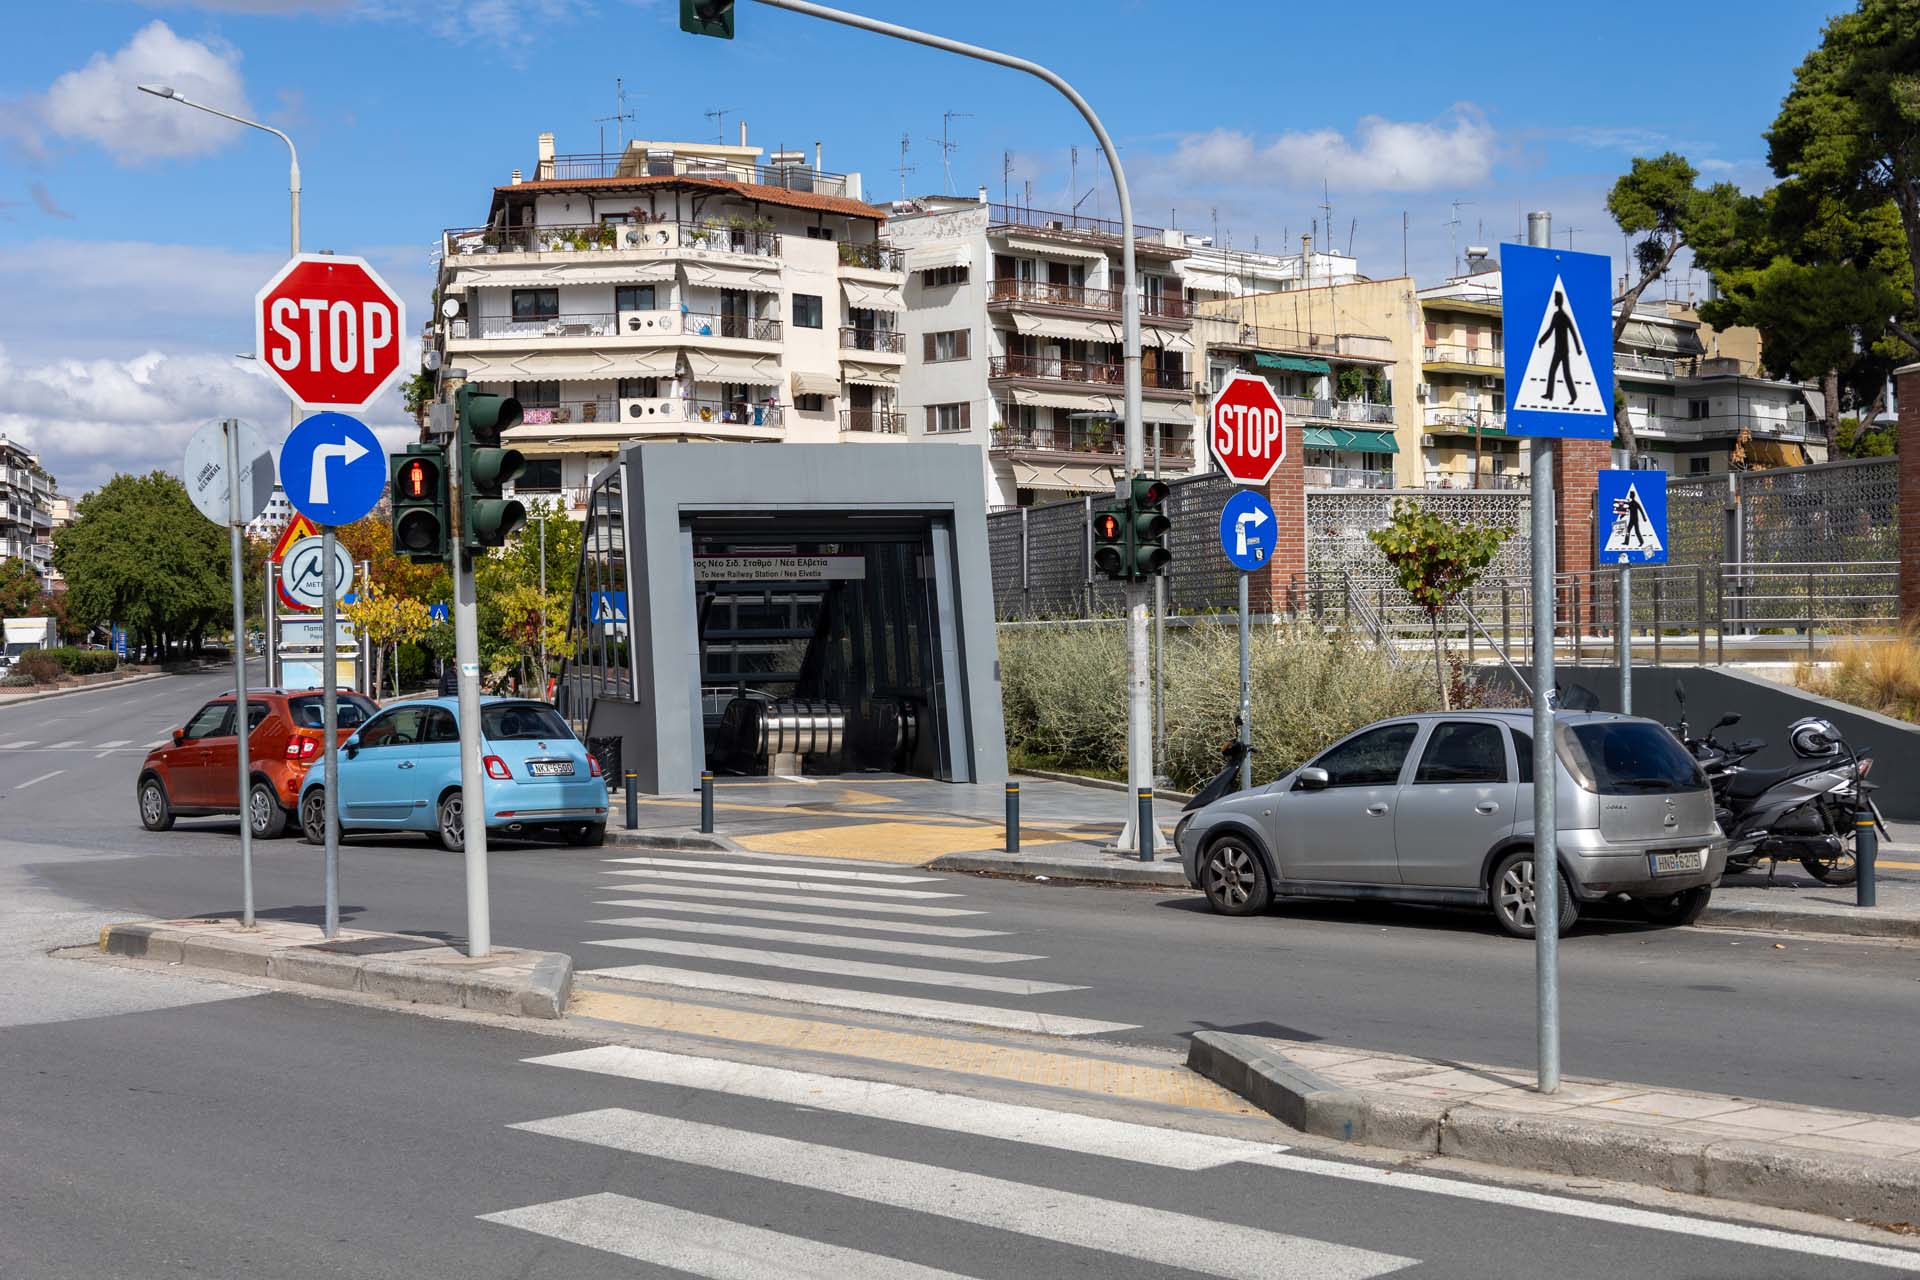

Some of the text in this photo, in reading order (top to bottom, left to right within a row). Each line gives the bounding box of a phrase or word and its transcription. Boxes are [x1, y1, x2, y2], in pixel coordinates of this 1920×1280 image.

[271, 297, 392, 375] STOP
[1218, 403, 1279, 459] STOP
[711, 570, 725, 578] New
[727, 570, 754, 579] Railway
